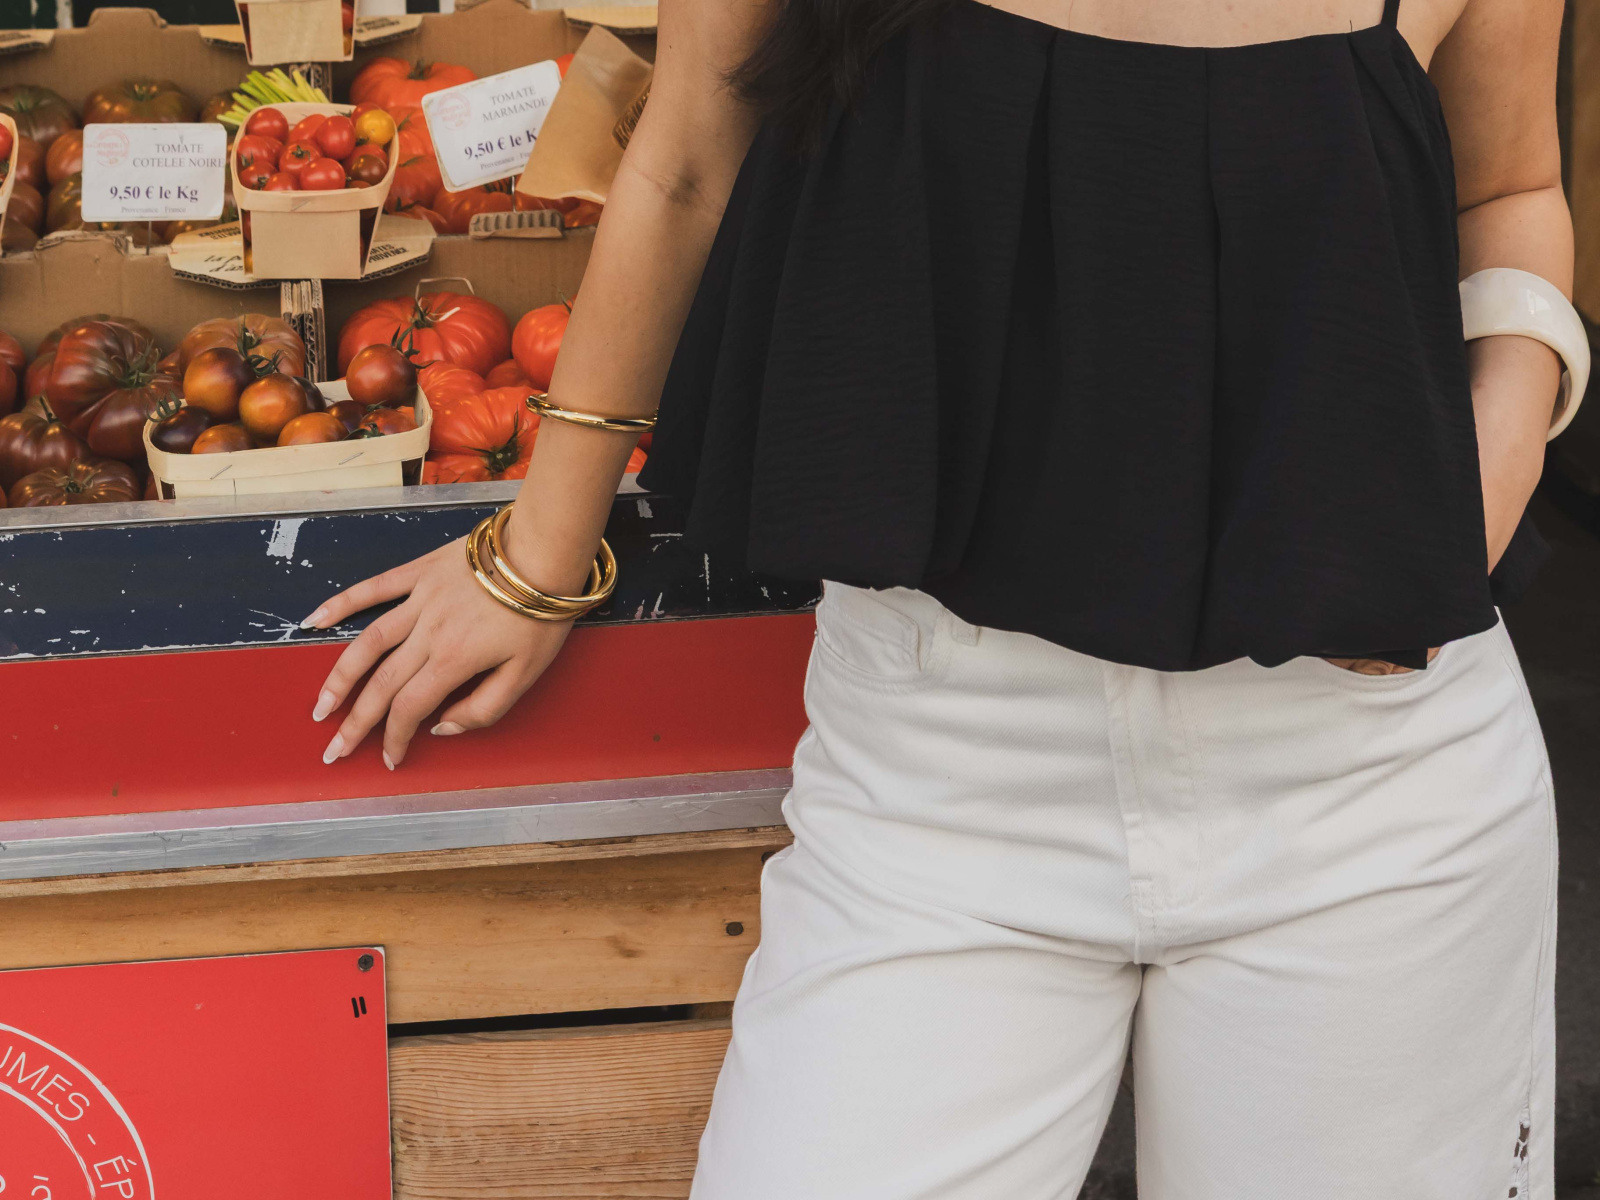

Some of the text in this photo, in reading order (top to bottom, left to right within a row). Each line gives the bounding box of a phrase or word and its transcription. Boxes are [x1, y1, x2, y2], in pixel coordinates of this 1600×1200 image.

[491, 85, 536, 105] TOMATE
[482, 97, 549, 122] MARMANDE
[155, 143, 204, 154] TOMATE
[464, 128, 538, 159] 9,50 € le K
[132, 157, 225, 169] COTELEE NOIRE
[110, 186, 199, 203] 9,50 € le Kg
[121, 206, 159, 214] Provenance
